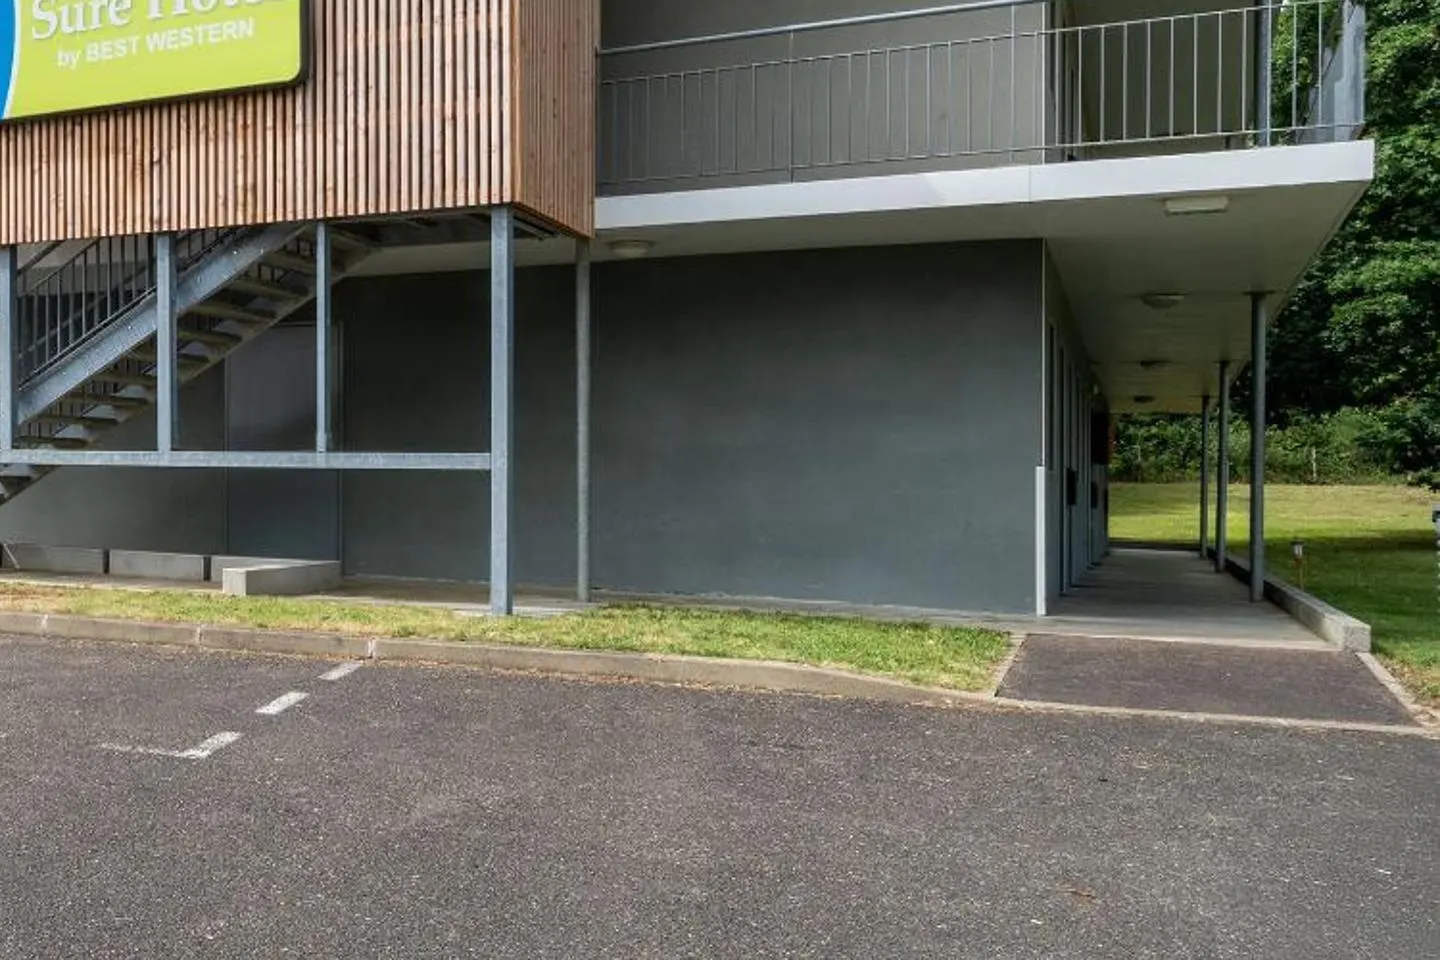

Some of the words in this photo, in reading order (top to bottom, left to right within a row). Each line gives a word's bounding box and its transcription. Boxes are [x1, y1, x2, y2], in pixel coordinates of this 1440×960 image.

[57, 48, 80, 70] by
[86, 36, 140, 62] BEST
[146, 16, 255, 53] WESTERN
